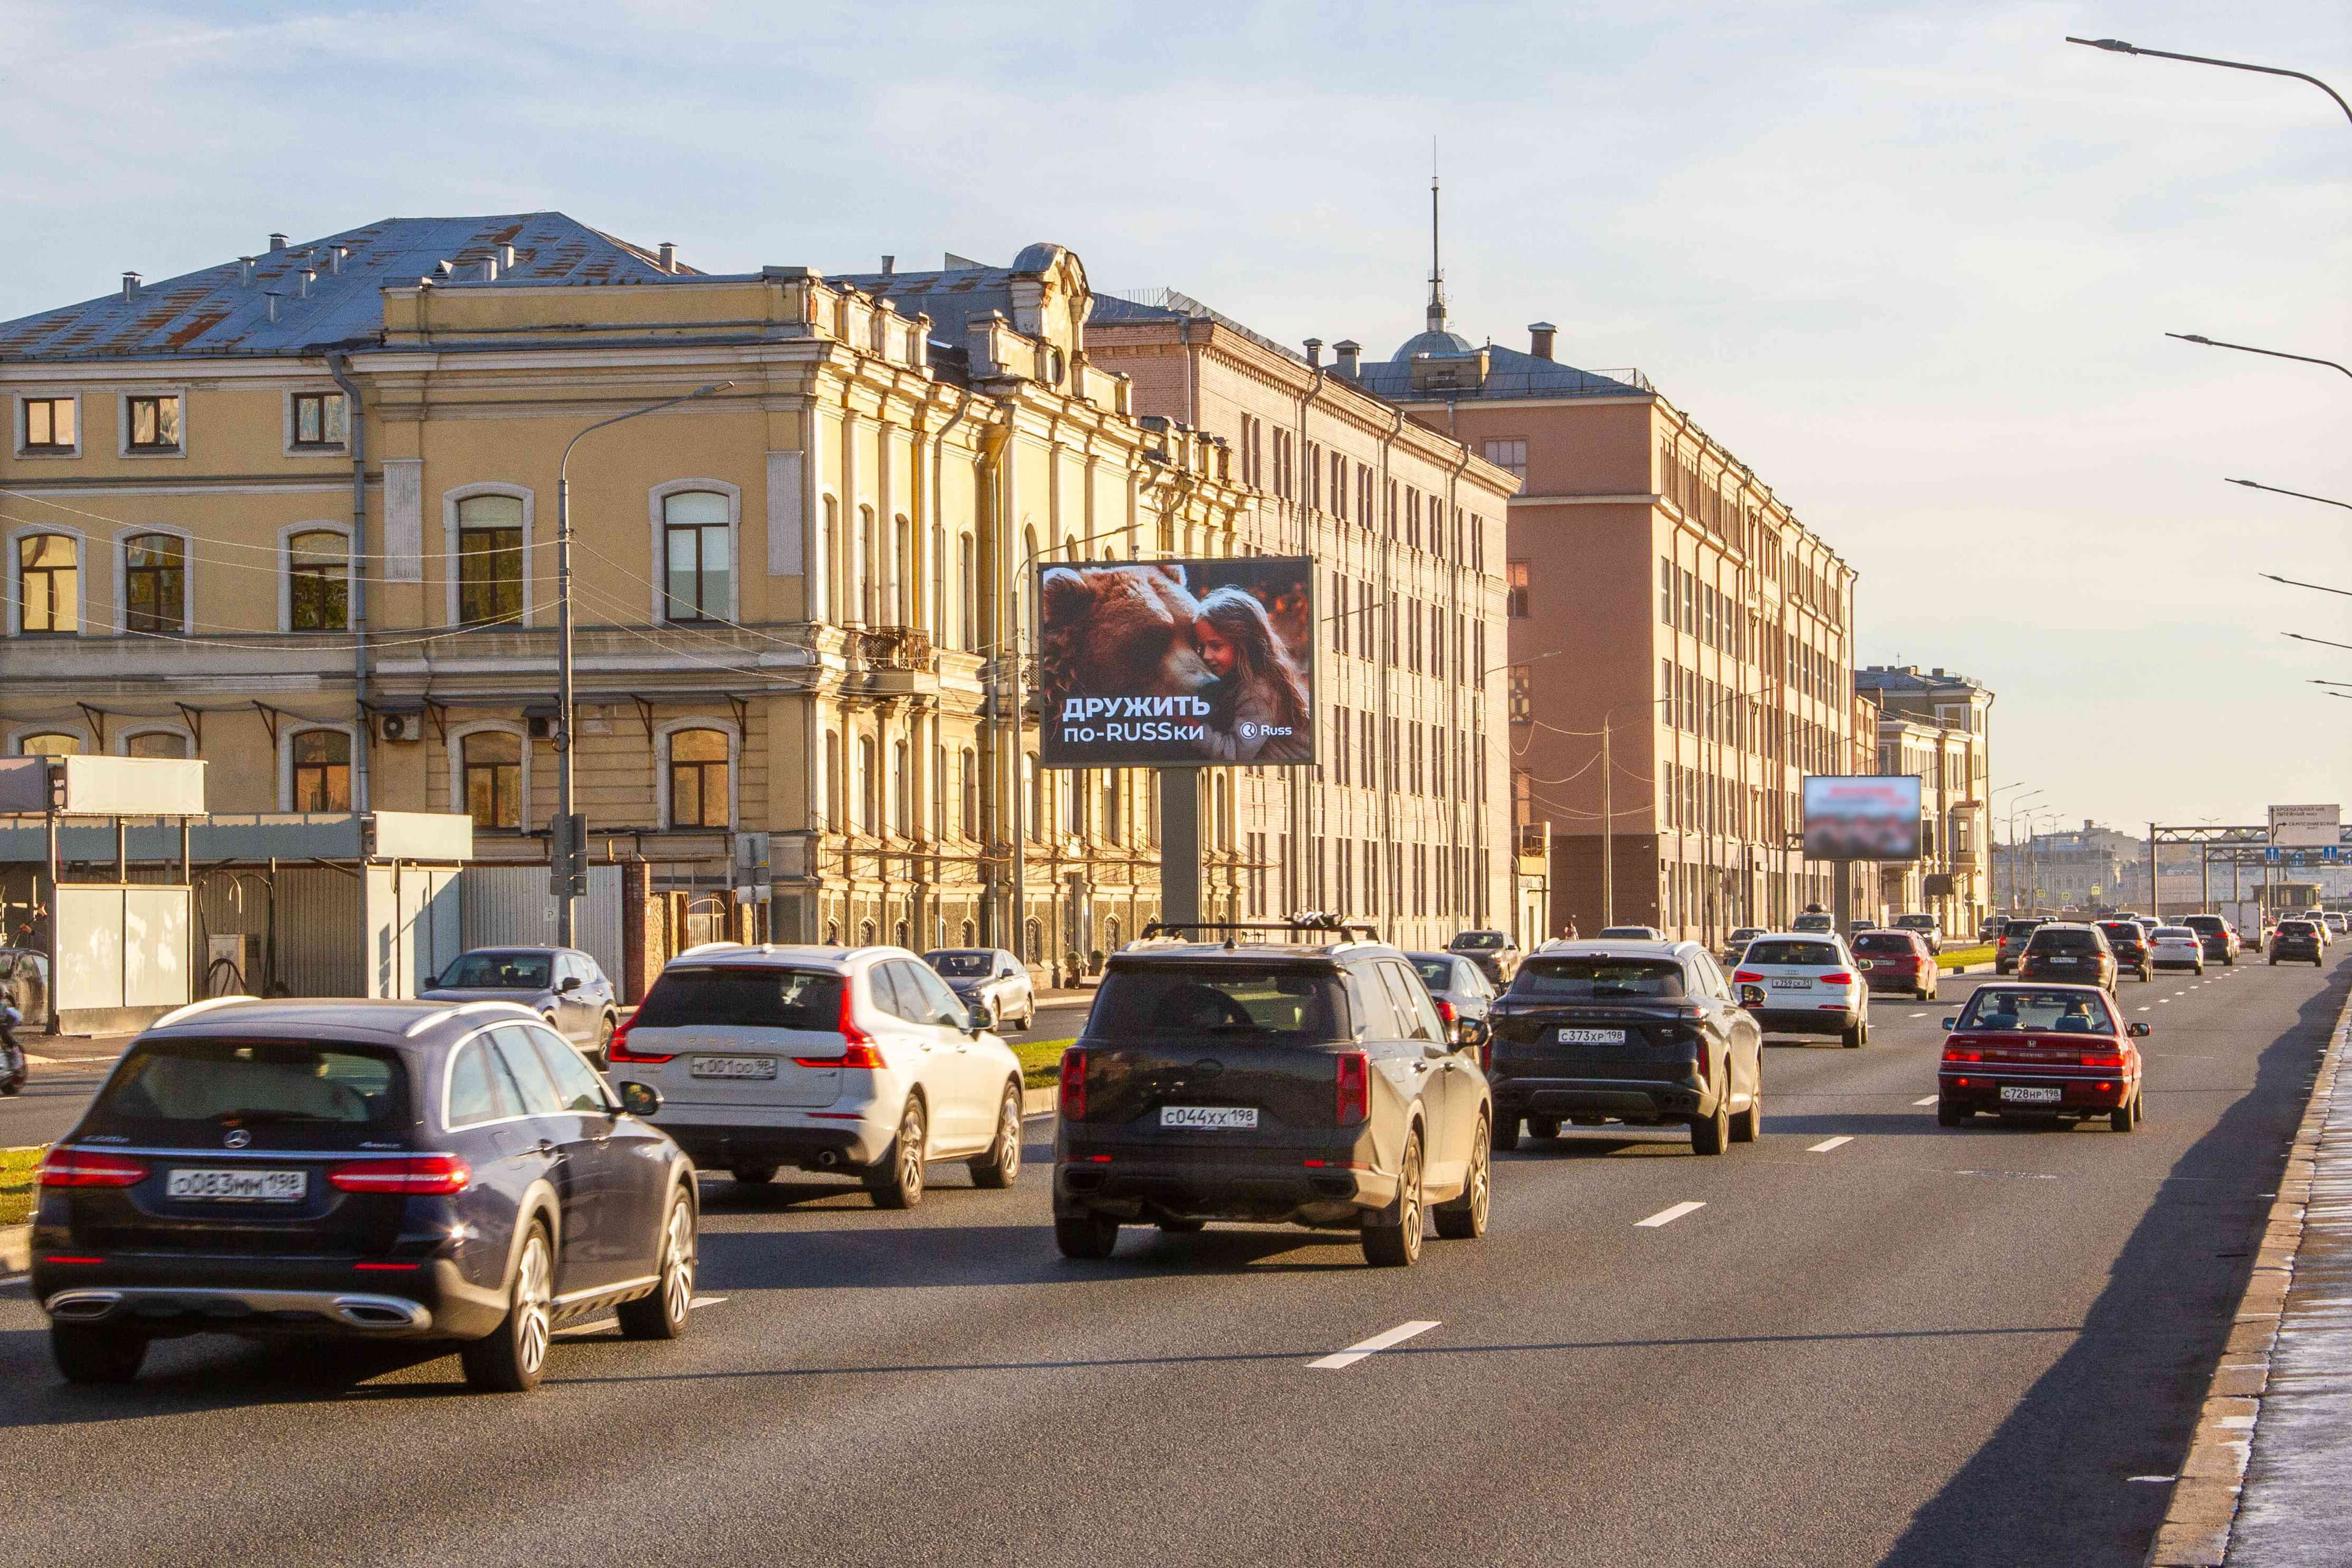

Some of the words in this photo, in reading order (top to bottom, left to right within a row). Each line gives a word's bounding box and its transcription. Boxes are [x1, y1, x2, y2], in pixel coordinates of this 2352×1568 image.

[1063, 696, 1210, 722] ДРУЖИТЬ
[1064, 722, 1204, 742] по-RUSSки
[1261, 725, 1292, 736] Russ
[1607, 1031, 1623, 1039] 198
[1231, 1109, 1254, 1121] 198
